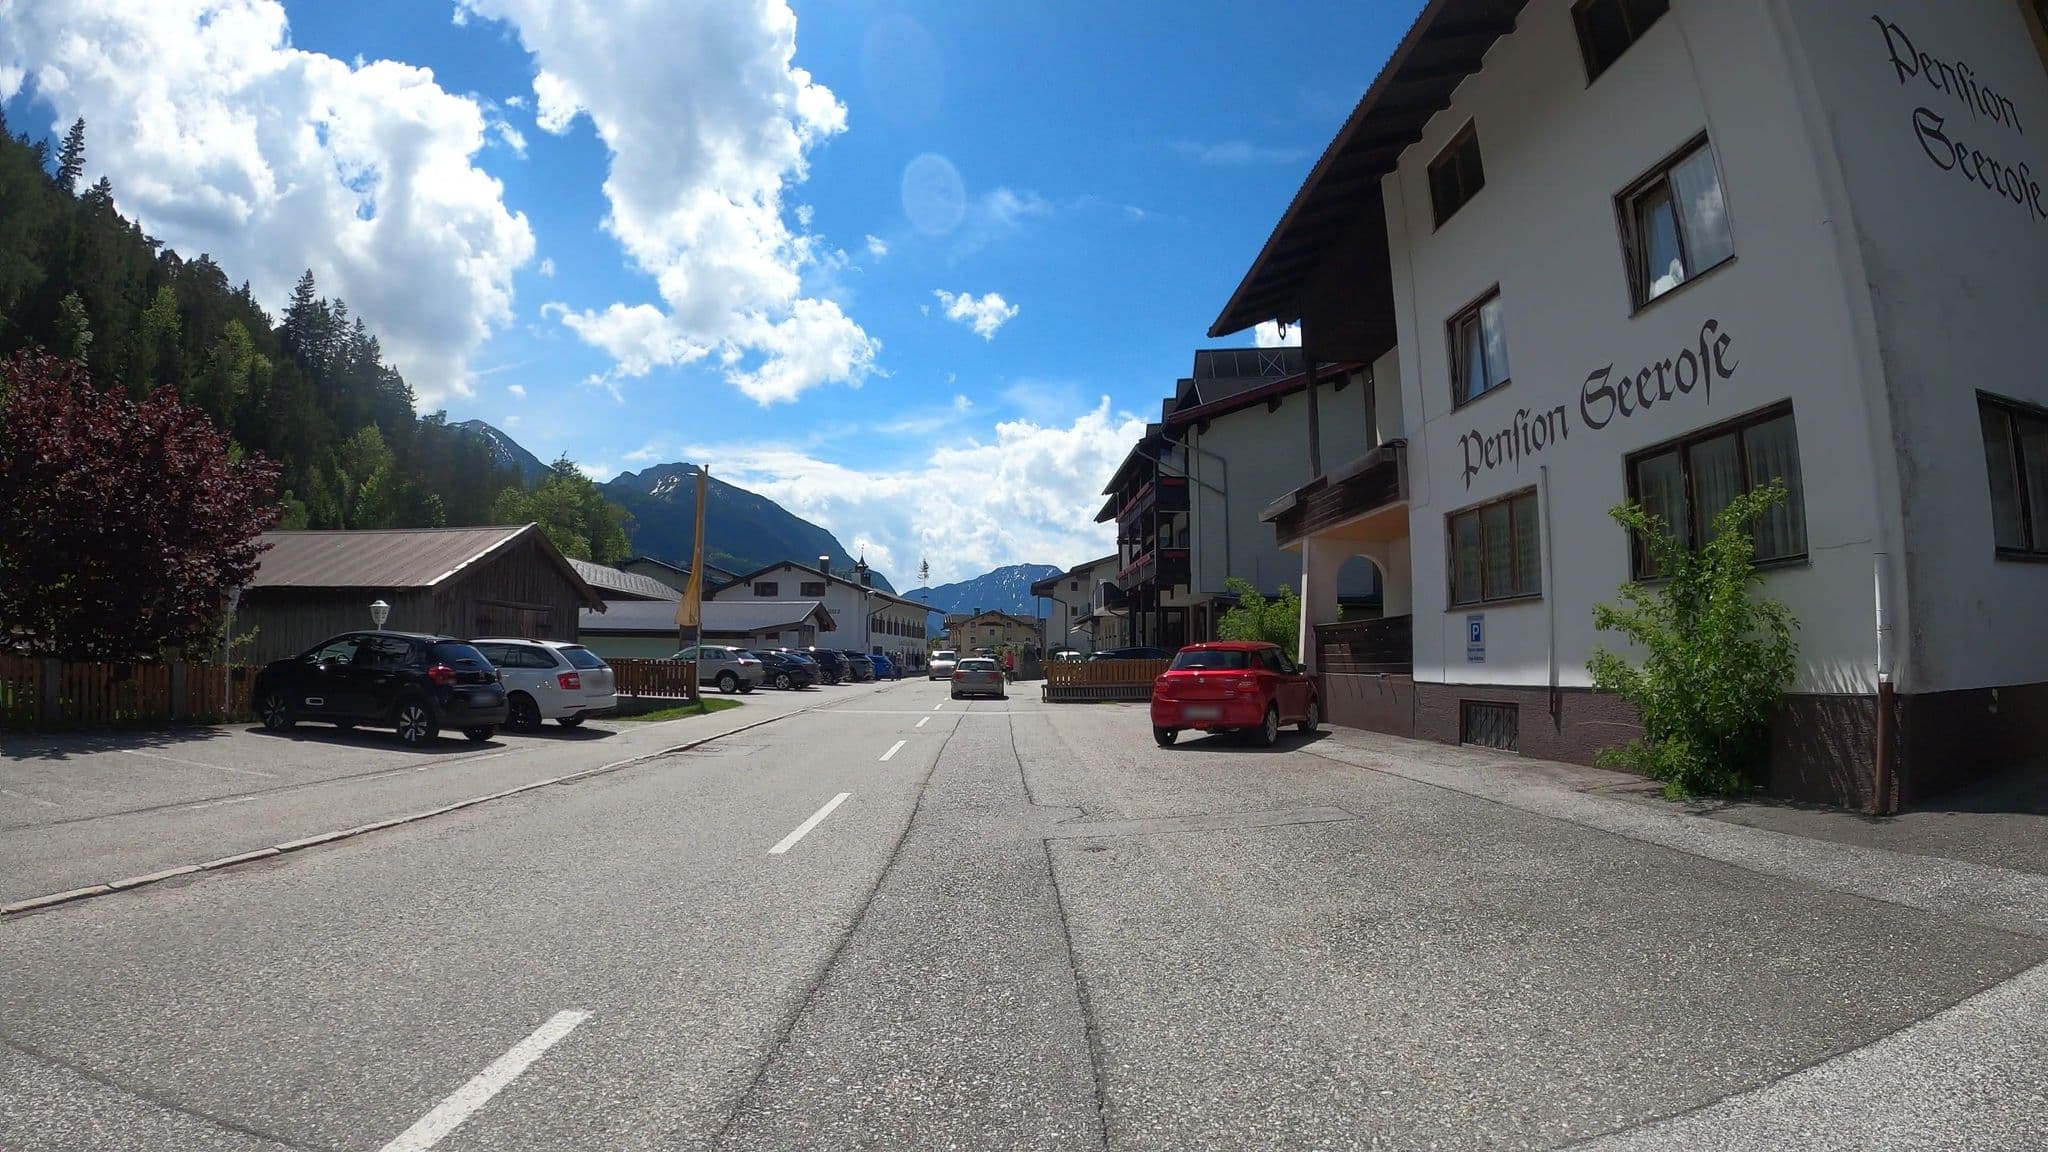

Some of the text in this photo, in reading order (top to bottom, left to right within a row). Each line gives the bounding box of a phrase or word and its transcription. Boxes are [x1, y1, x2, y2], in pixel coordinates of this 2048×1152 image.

[1871, 14, 2023, 136] Pension
[1912, 107, 2048, 223] Seerose
[1457, 318, 1740, 493] Pension Seerose
[1472, 624, 1480, 641] P
